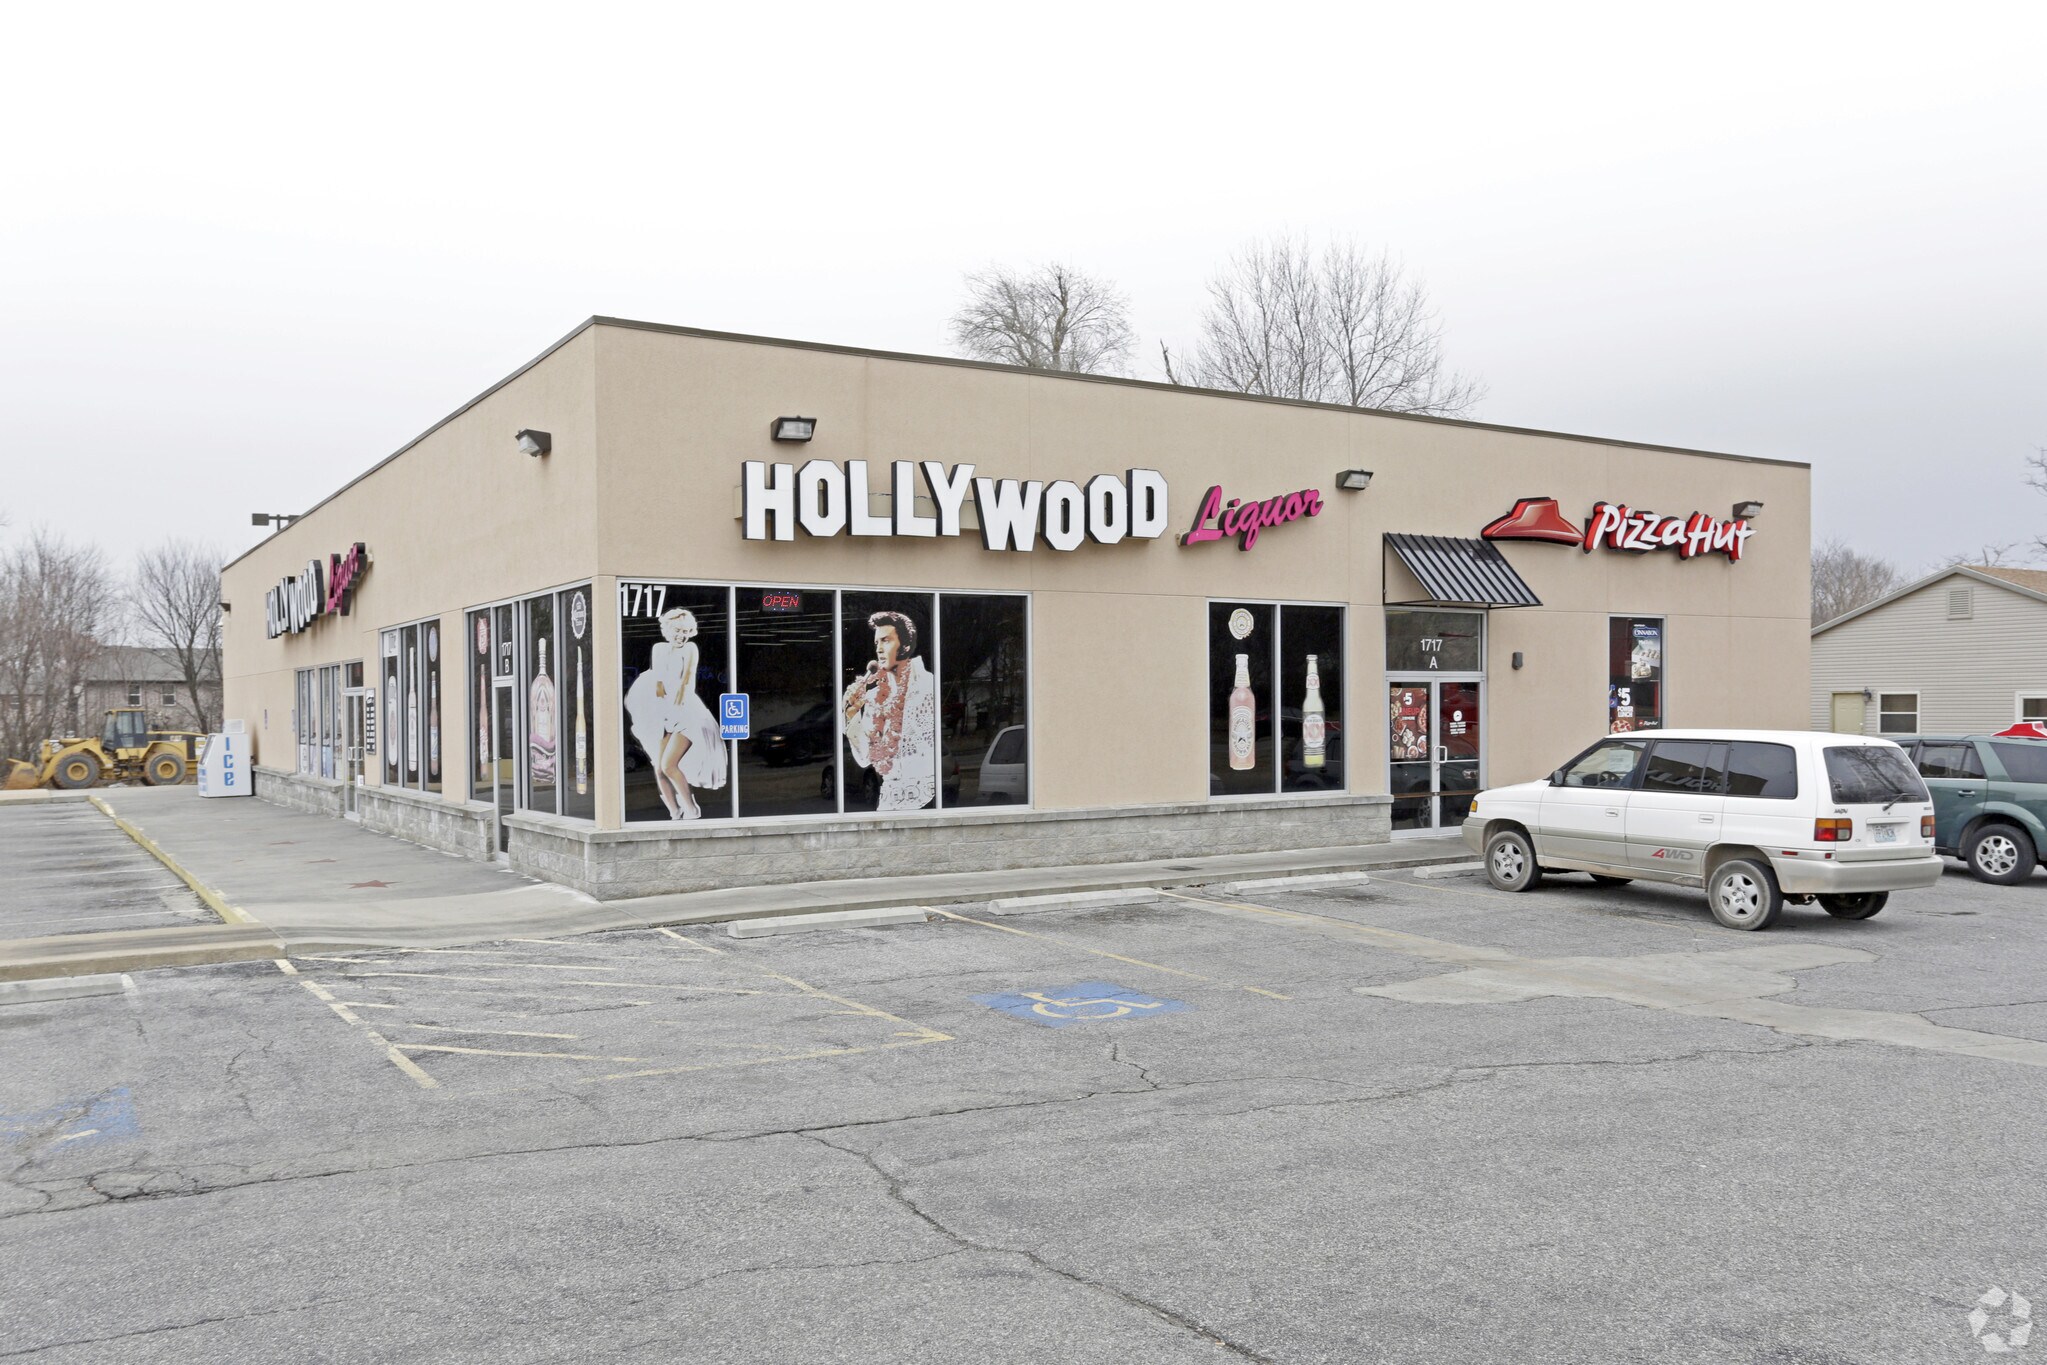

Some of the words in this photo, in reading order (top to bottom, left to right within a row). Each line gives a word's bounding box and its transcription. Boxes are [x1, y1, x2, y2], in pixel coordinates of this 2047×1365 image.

[742, 459, 1169, 552] HOLLYWOOD
[1182, 485, 1323, 551] Liquor
[621, 584, 667, 618] 1717
[762, 594, 800, 608] OPEN
[1420, 638, 1442, 652] 1717
[1429, 656, 1438, 669] A
[1617, 687, 1631, 706] $5
[721, 724, 748, 734] PARKING
[1651, 848, 1694, 861] 4WD
